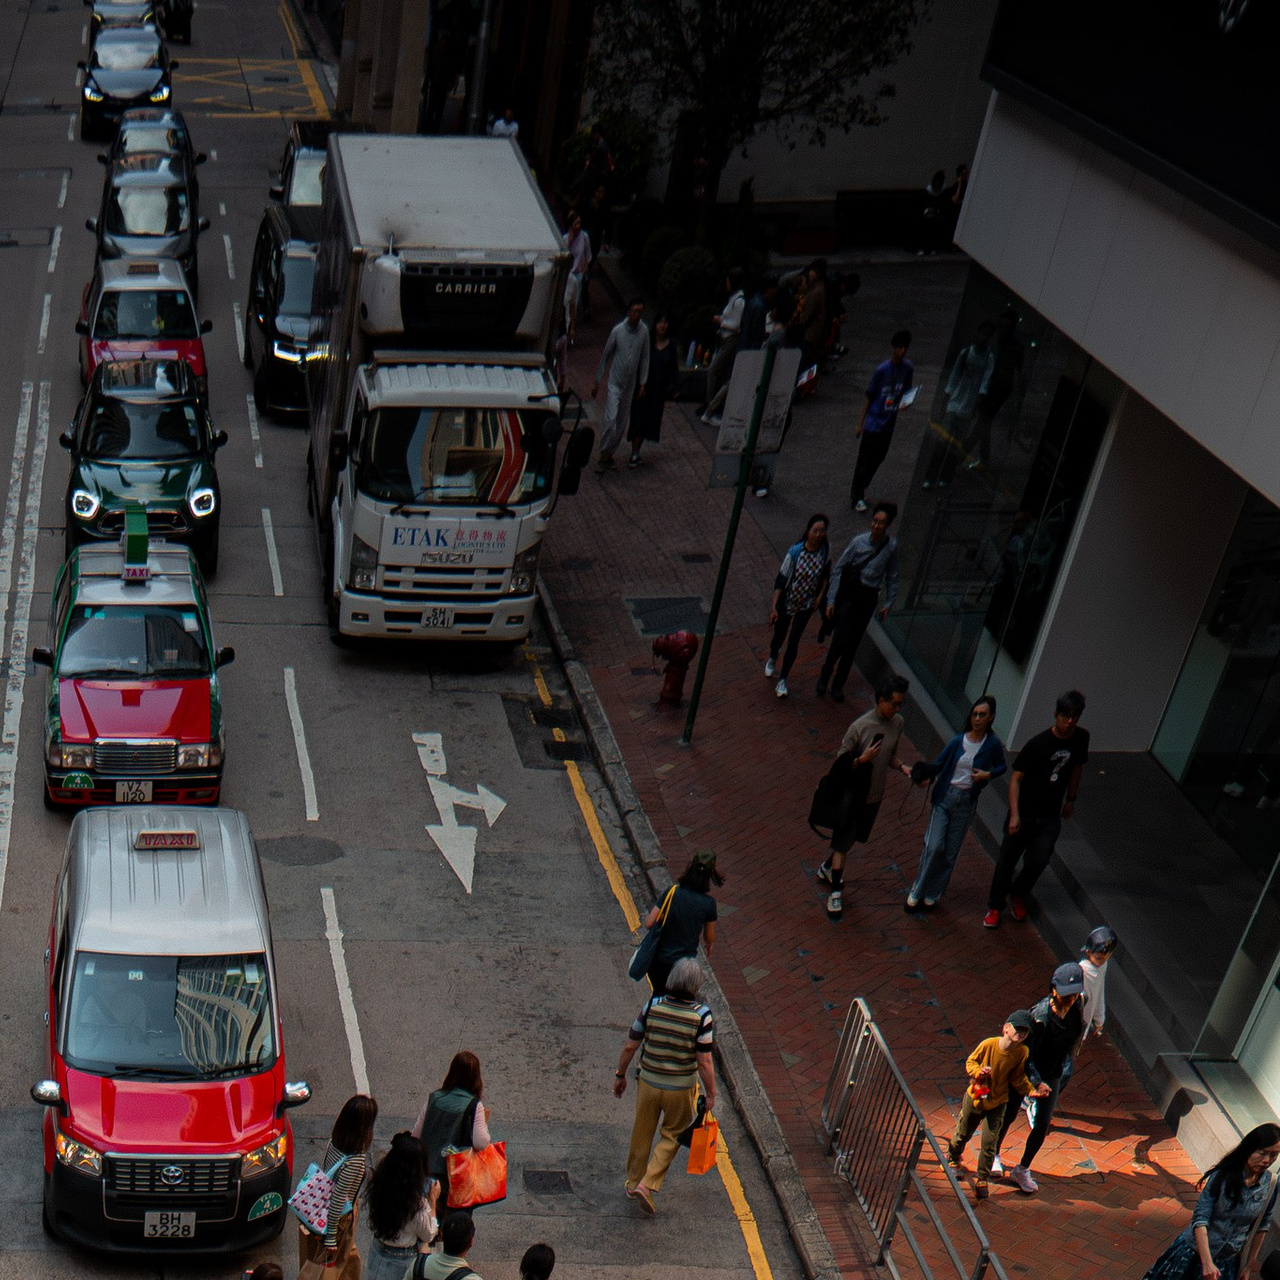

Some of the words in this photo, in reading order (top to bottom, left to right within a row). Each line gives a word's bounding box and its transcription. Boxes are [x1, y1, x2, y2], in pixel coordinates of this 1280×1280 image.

[435, 282, 497, 294] CARRIER
[392, 527, 450, 547] ETAK
[422, 552, 473, 565] ISUZU
[125, 568, 149, 577] TAXI
[431, 608, 446, 617] SH
[425, 616, 450, 627] 5041
[127, 782, 141, 792] VZ
[122, 792, 145, 802] 1120
[142, 834, 194, 846] TAXI
[263, 1200, 271, 1209] 4
[159, 1213, 181, 1225] BH
[148, 1225, 191, 1237] 3228
